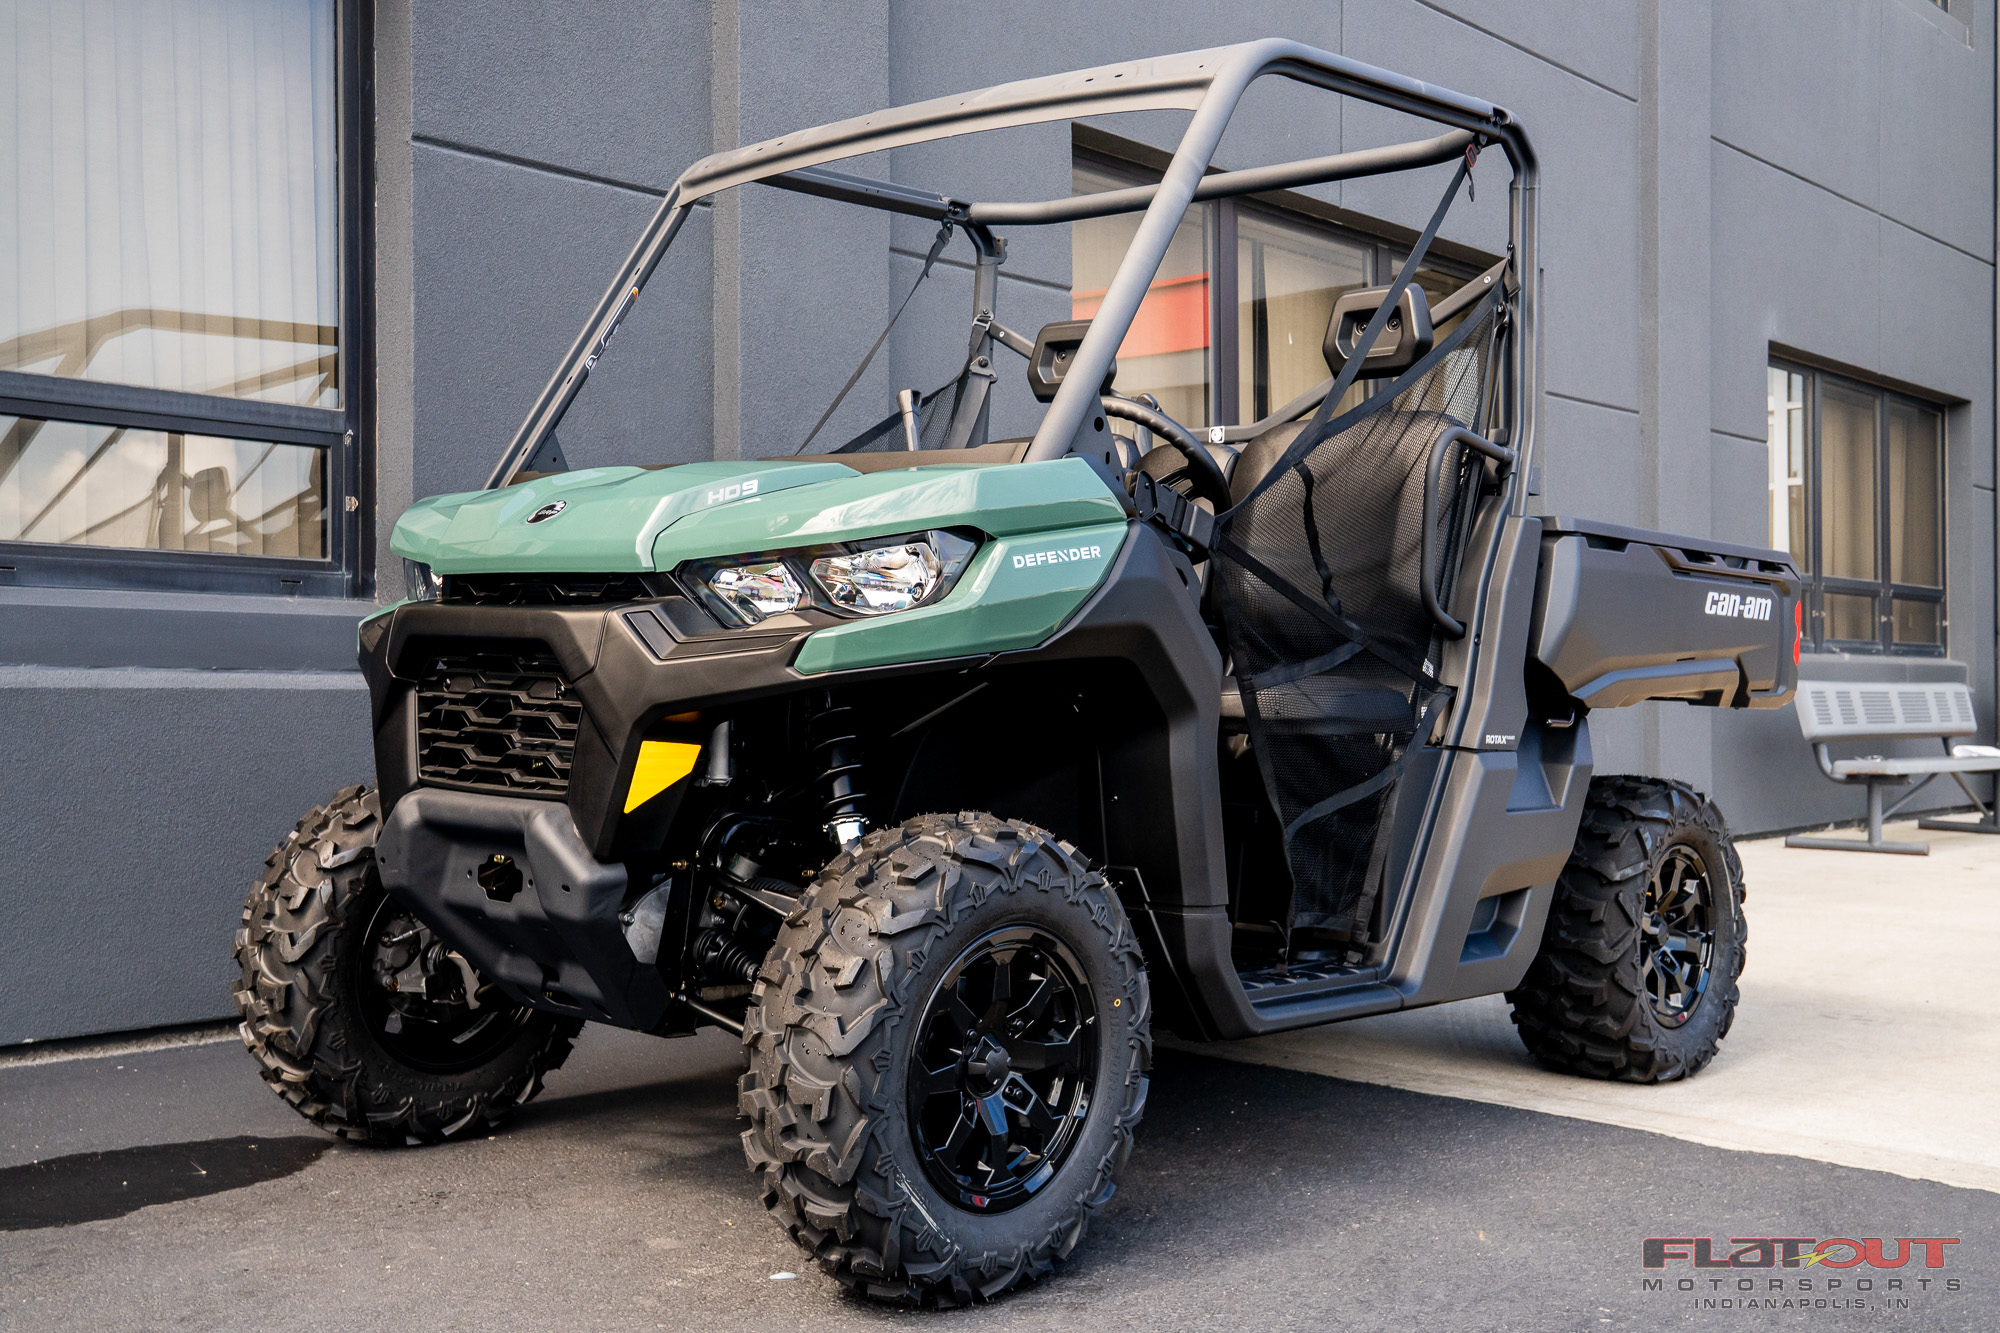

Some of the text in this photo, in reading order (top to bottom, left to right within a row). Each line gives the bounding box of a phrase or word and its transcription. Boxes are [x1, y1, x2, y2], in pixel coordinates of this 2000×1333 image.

[707, 479, 759, 505] HD9
[1012, 545, 1102, 569] DEFENDER
[1704, 591, 1773, 621] can-am
[1485, 734, 1507, 745] ROTAX
